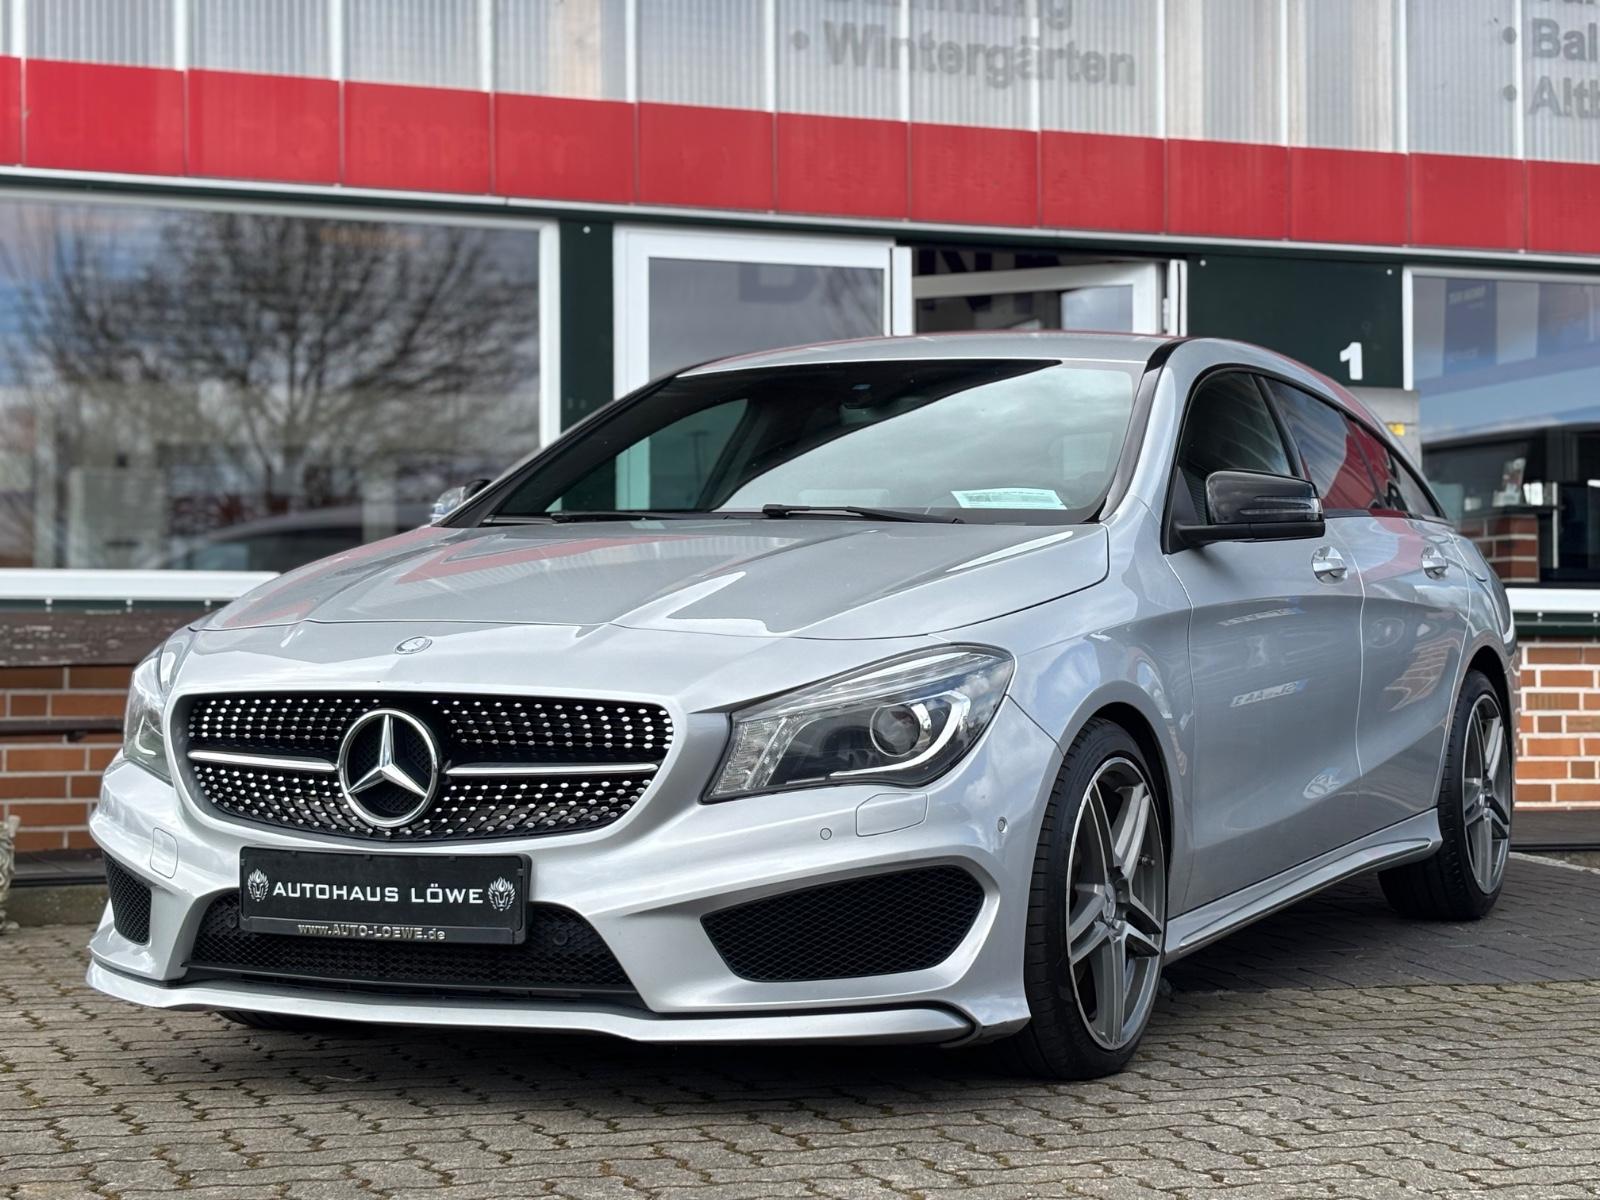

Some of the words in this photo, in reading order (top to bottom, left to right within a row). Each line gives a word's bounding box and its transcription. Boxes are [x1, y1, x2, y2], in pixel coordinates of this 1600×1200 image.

[823, 20, 1136, 90] Wintergärten
[1339, 341, 1363, 381] 1
[273, 882, 399, 903] AUTOHAUS
[411, 883, 484, 904] LÖWE
[298, 924, 446, 941] www.AUTO-LOEWE.de
